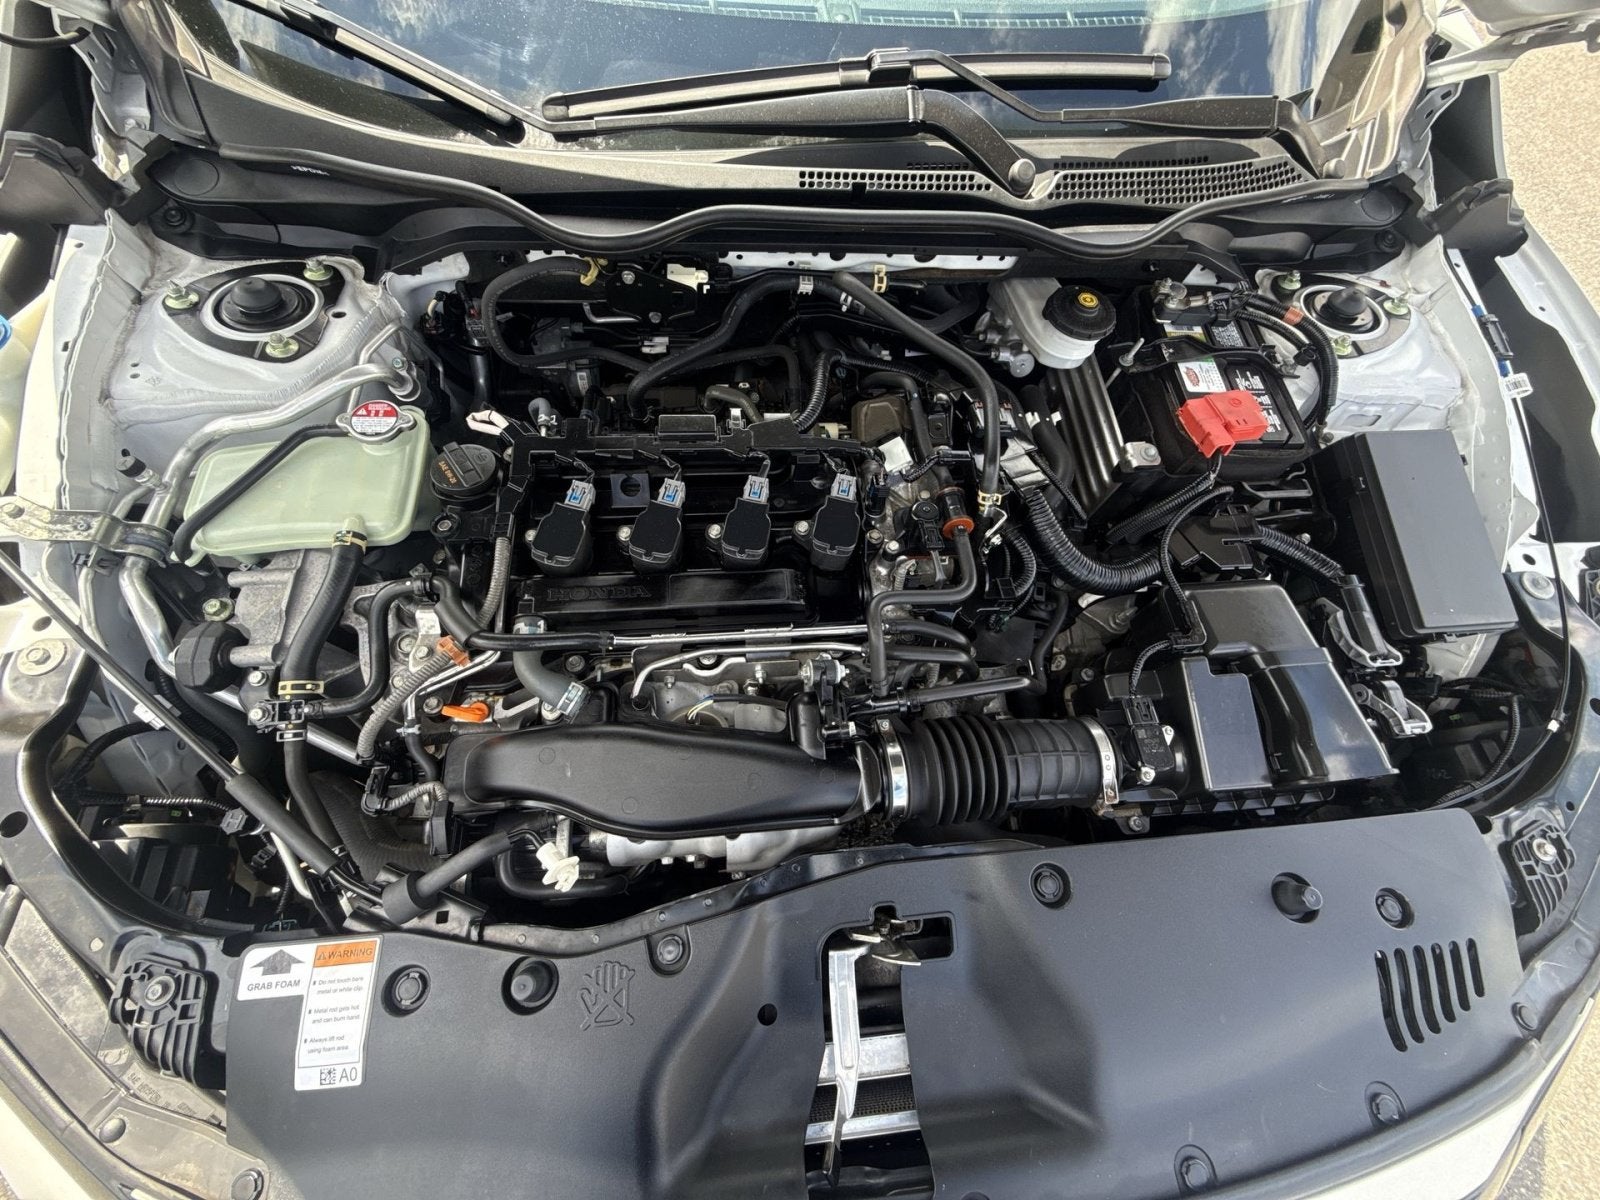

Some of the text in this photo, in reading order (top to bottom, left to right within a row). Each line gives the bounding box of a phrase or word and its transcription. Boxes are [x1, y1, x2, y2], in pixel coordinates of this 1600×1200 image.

[547, 585, 652, 601] HONDA
[328, 948, 373, 960] WARNING
[247, 979, 300, 991] GRAB FOAM
[309, 1037, 327, 1045] Always
[339, 1066, 358, 1083] A0
